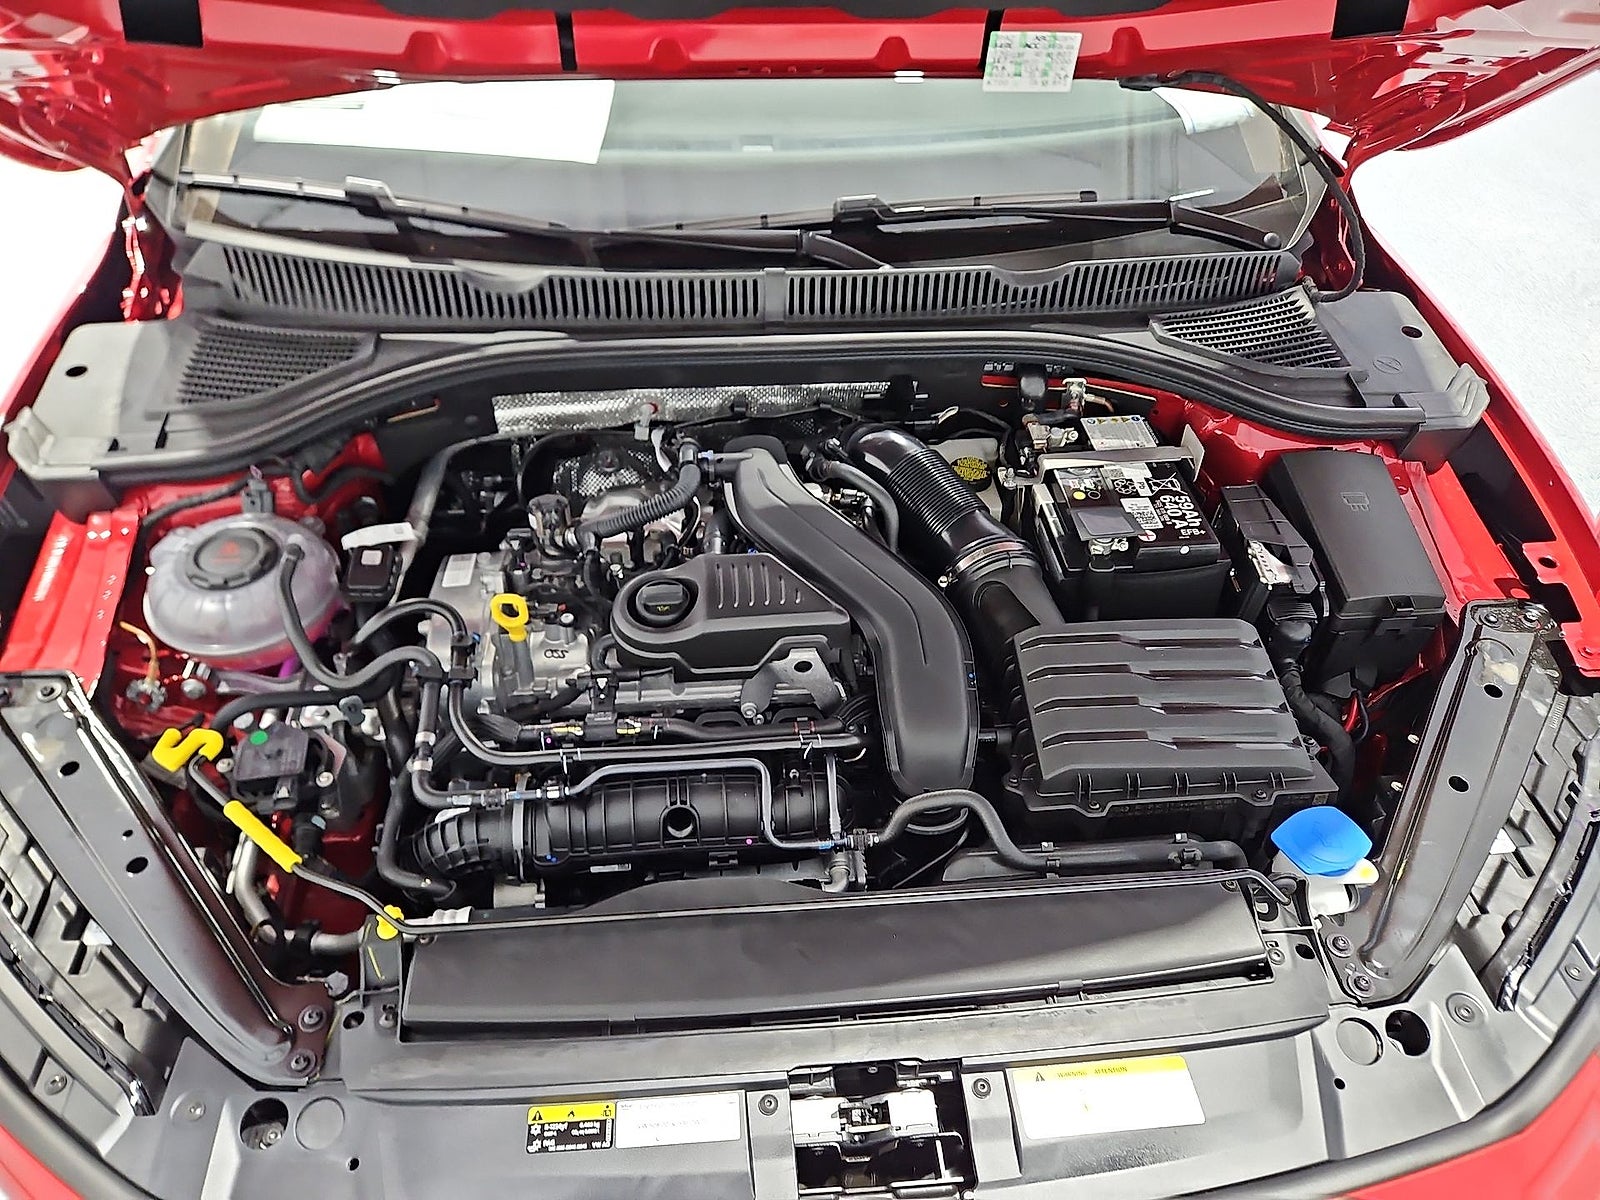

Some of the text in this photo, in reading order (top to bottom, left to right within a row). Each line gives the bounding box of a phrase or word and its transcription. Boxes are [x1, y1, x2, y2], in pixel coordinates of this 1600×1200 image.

[1160, 495, 1183, 517] 640
[1175, 496, 1203, 527] 59Ah
[1171, 519, 1189, 529] A
[1094, 1066, 1128, 1075] ATTENTION
